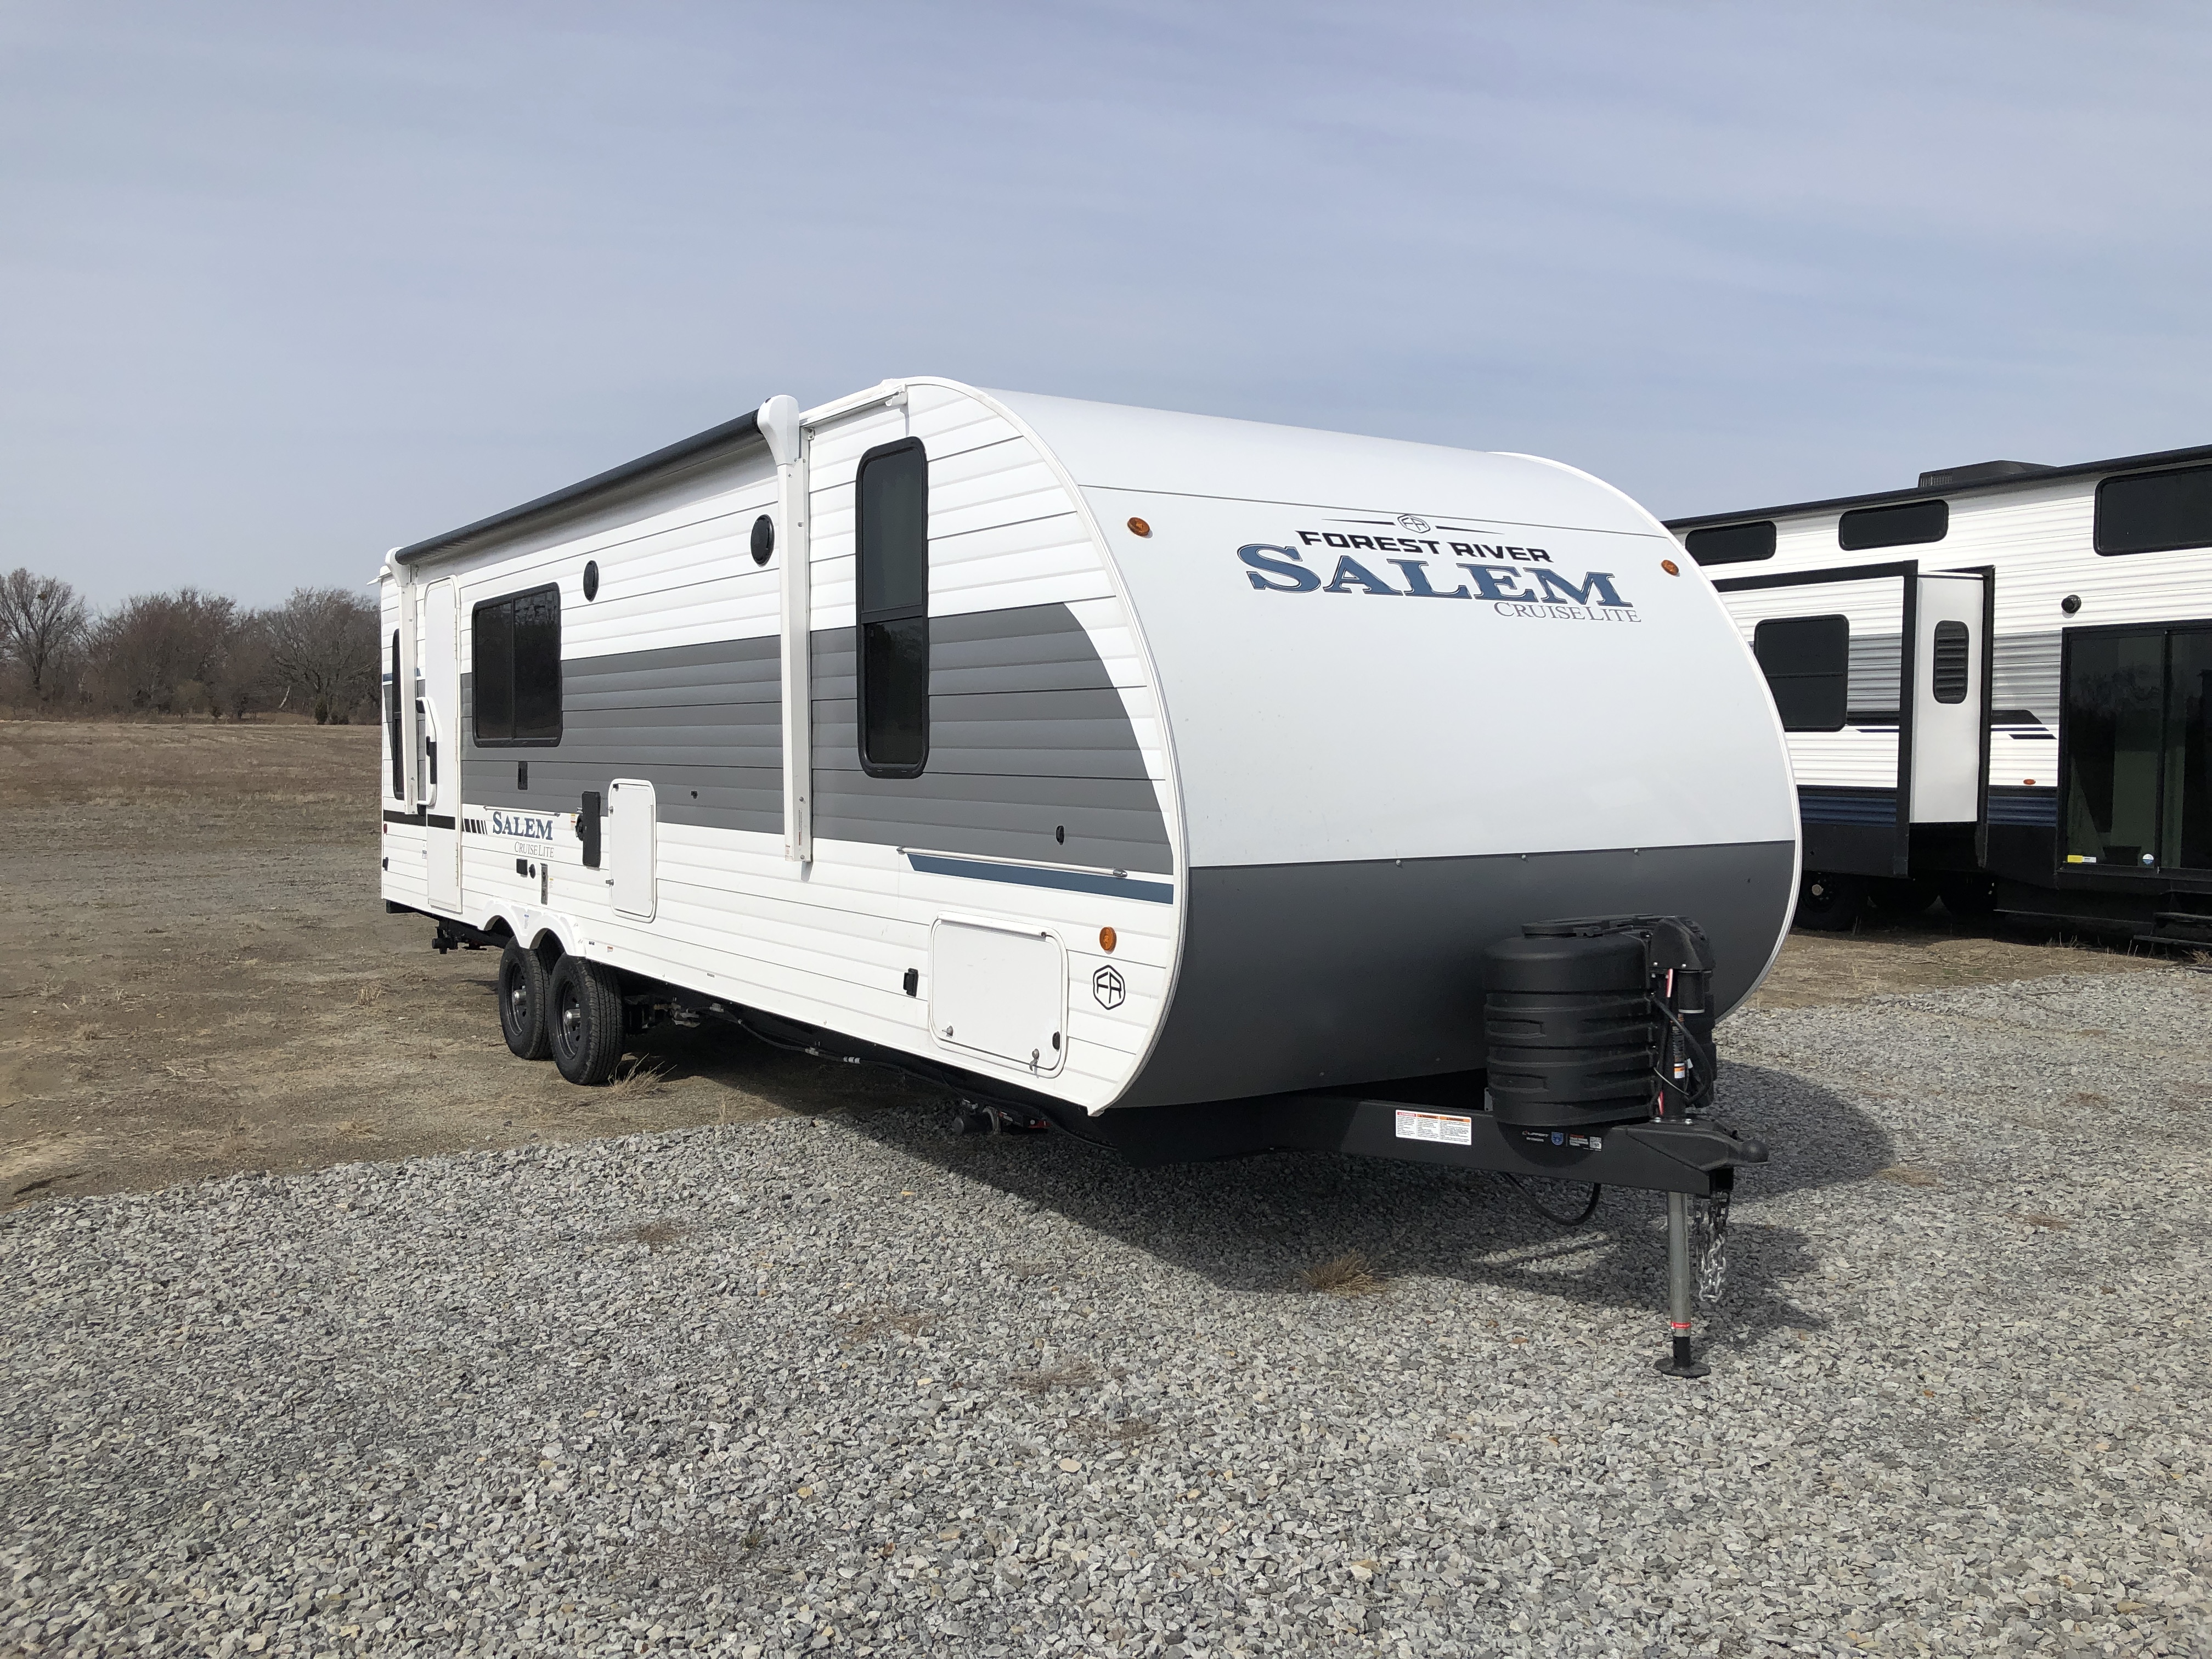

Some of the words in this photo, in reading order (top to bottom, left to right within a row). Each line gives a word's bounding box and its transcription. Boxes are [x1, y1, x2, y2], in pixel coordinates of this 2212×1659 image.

[1295, 530, 1440, 555] FOREST
[1446, 541, 1554, 563] RIVER
[1237, 543, 1633, 608] SALEM
[492, 811, 553, 840] SALEM
